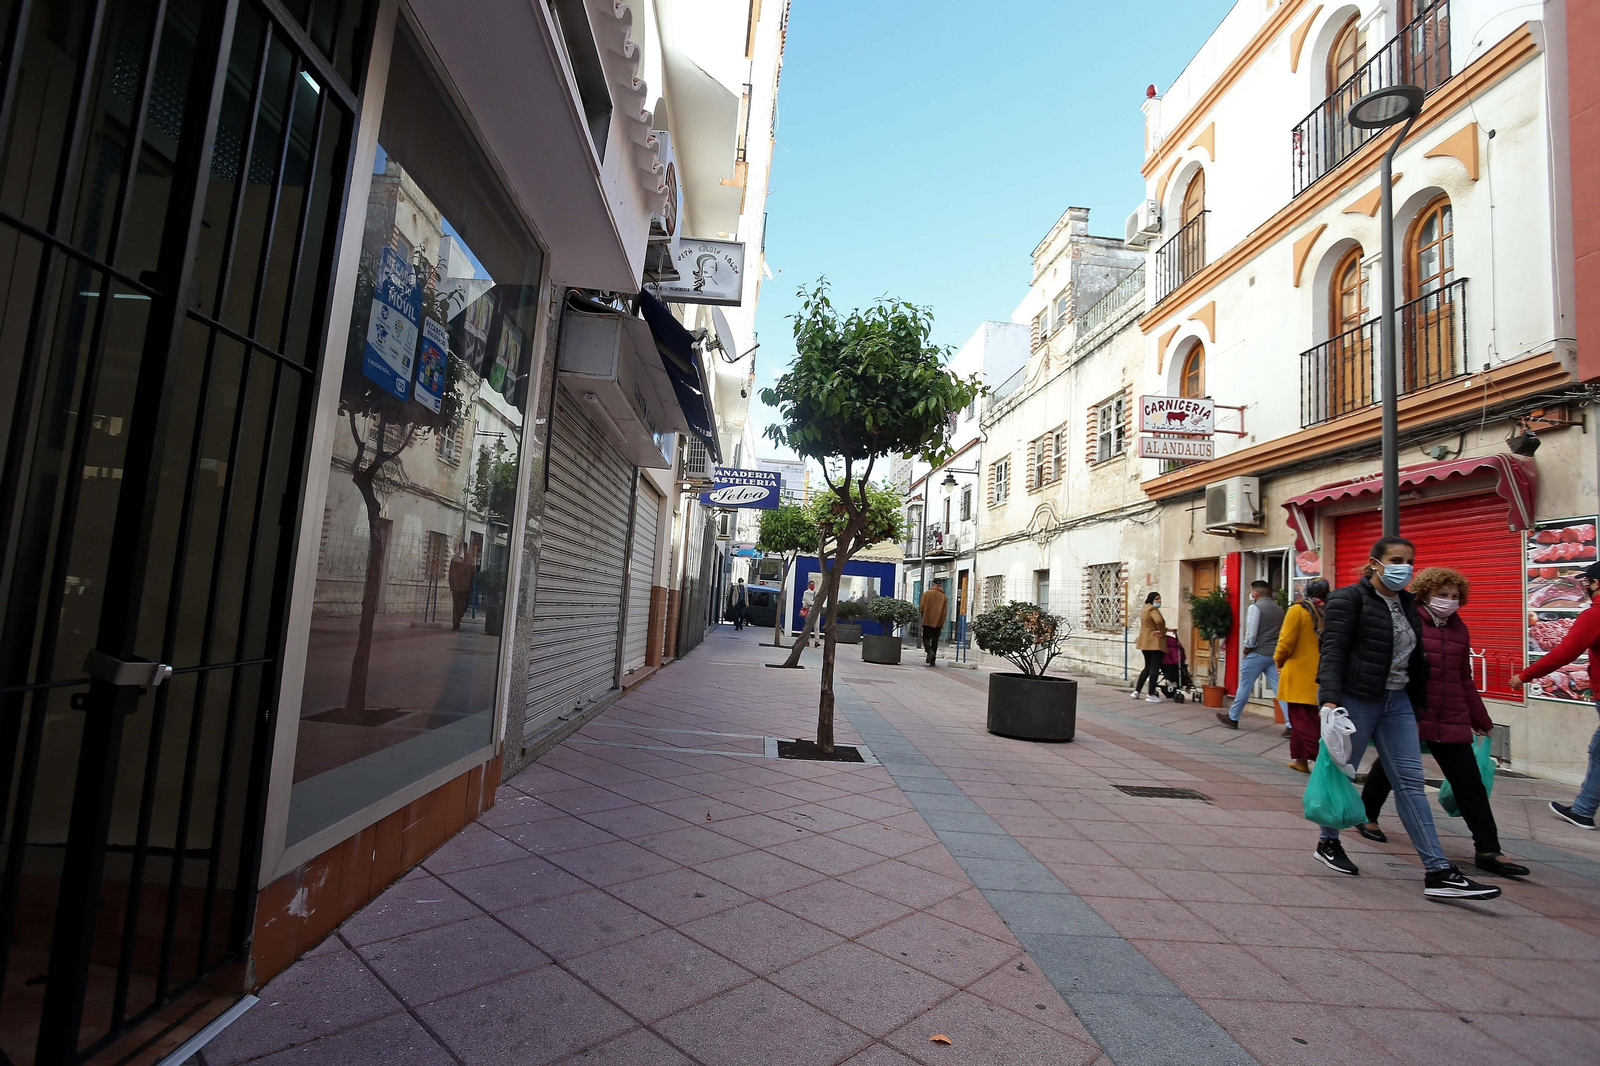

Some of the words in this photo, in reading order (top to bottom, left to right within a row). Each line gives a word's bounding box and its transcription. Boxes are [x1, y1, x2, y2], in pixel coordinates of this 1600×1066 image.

[1144, 399, 1212, 420] CARNICERIA
[1145, 441, 1159, 454] AL
[1162, 441, 1212, 457] ANDALUS
[714, 469, 776, 479] ANADERIA
[713, 477, 777, 487] ASTELERIA
[713, 488, 765, 501] Selva
